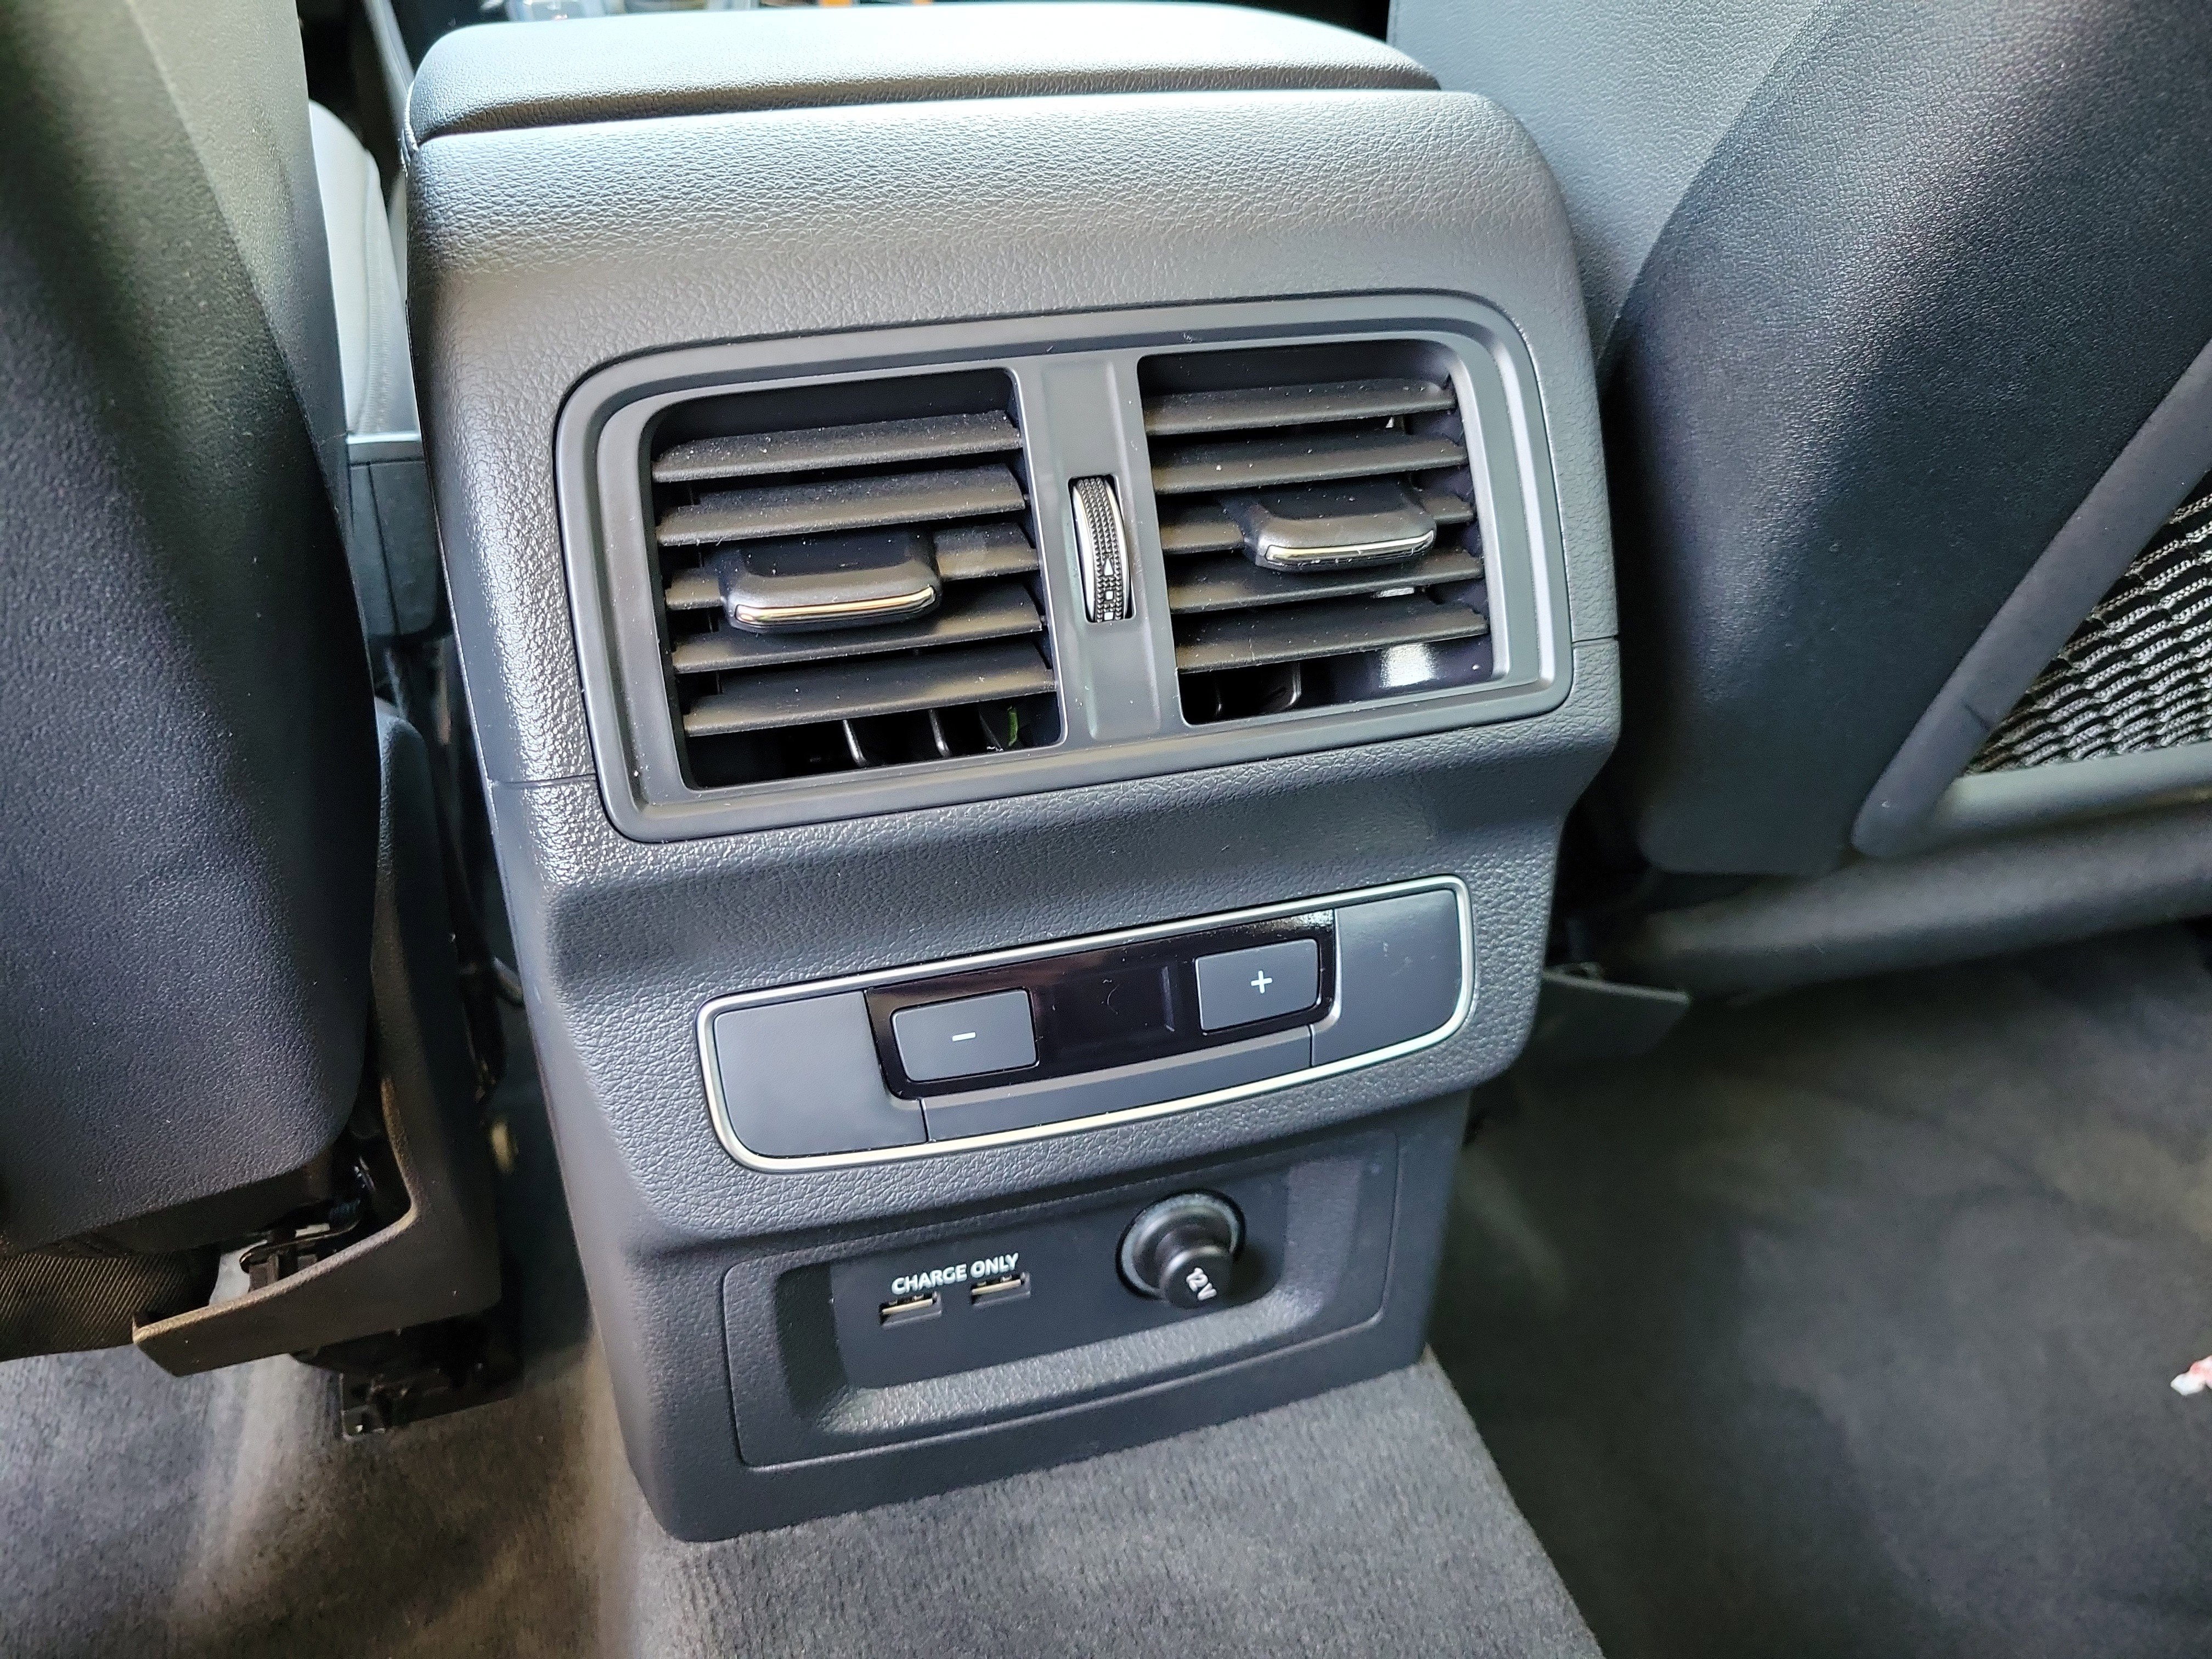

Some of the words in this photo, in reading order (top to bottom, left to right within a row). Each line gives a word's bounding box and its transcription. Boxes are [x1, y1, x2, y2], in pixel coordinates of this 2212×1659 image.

[891, 1263, 967, 1295] CHARGE
[970, 1252, 1019, 1278] ONLY
[1186, 1267, 1217, 1301] 12V
